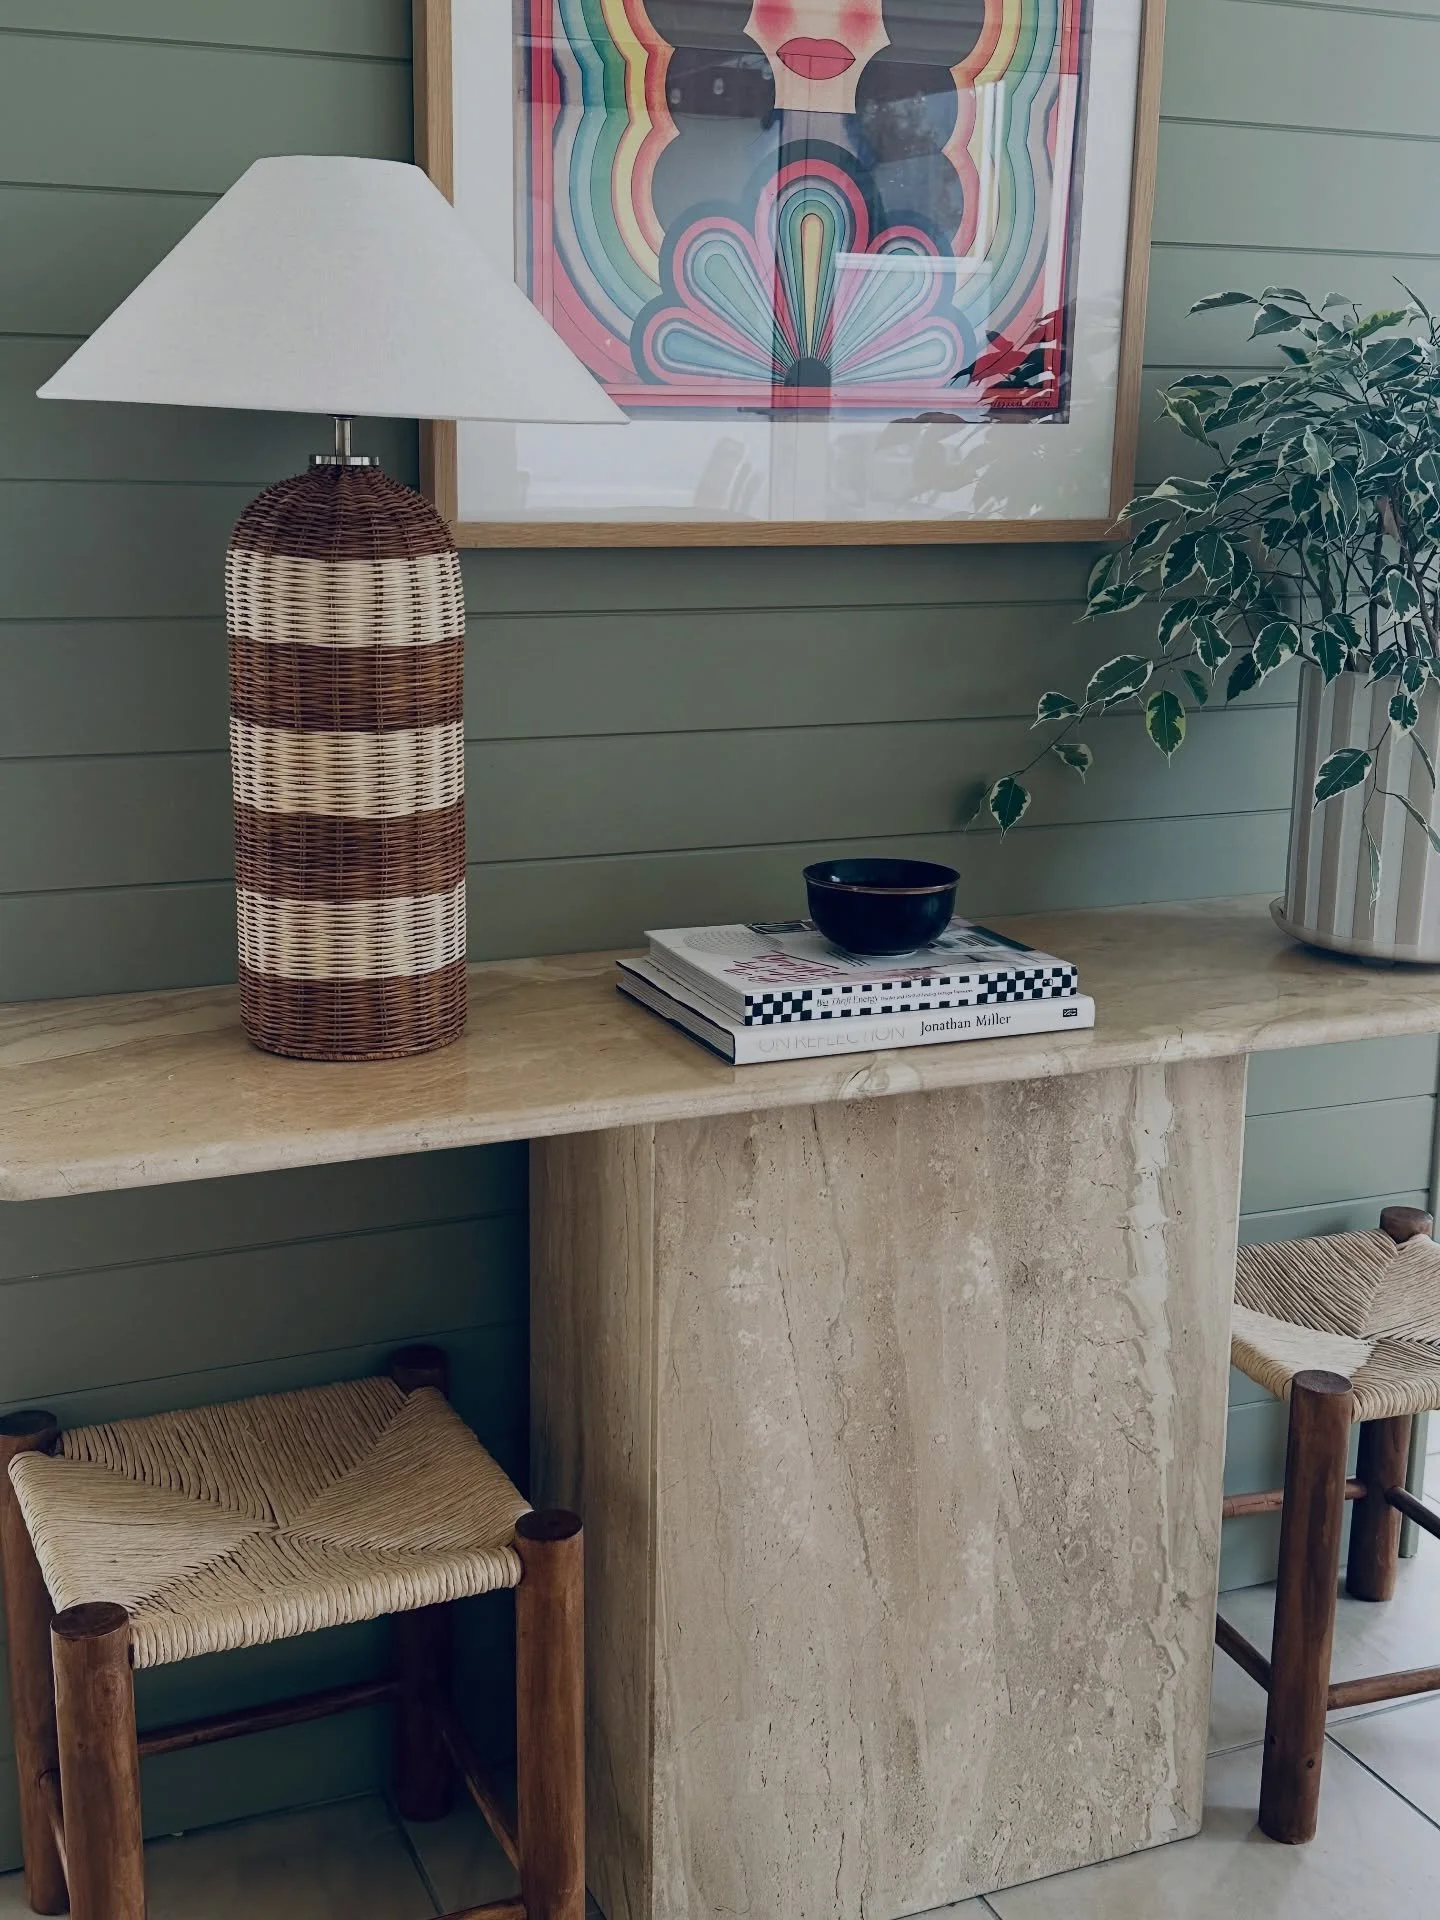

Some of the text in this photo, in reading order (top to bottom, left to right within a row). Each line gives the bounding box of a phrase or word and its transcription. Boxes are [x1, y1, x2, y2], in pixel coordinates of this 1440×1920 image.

[853, 995, 878, 1005] Energy
[919, 1013, 1012, 1036] Jonathan Miller
[758, 1026, 906, 1053] ON REFLECTION
